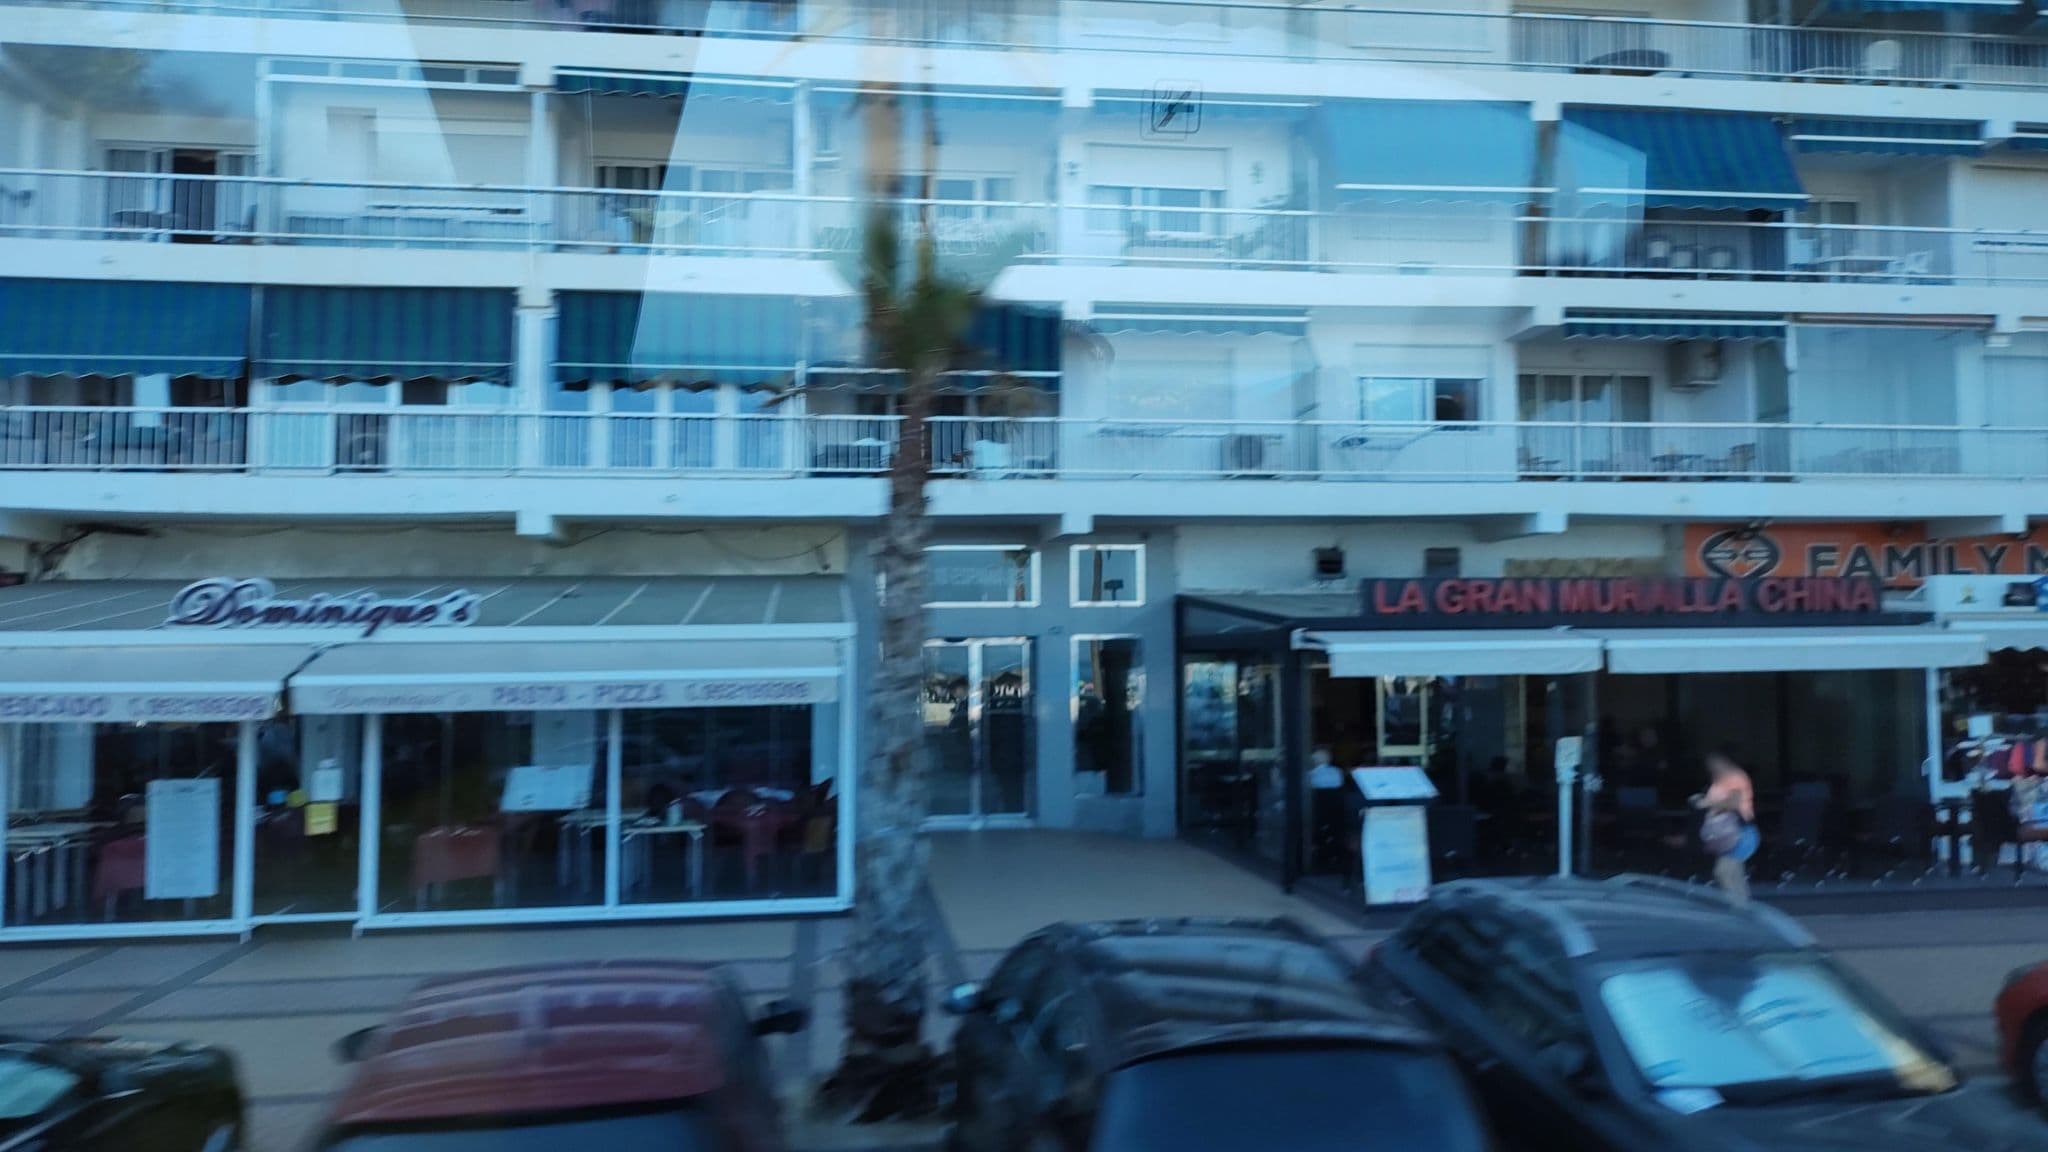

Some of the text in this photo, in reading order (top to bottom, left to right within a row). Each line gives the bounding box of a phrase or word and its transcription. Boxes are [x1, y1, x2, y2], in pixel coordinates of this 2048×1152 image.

[1805, 543, 2010, 581] FAMILY
[165, 577, 481, 638] Dominique's
[1374, 577, 1877, 613] LA GRAN MURALLA CHINA
[594, 683, 665, 703] PIZZA
